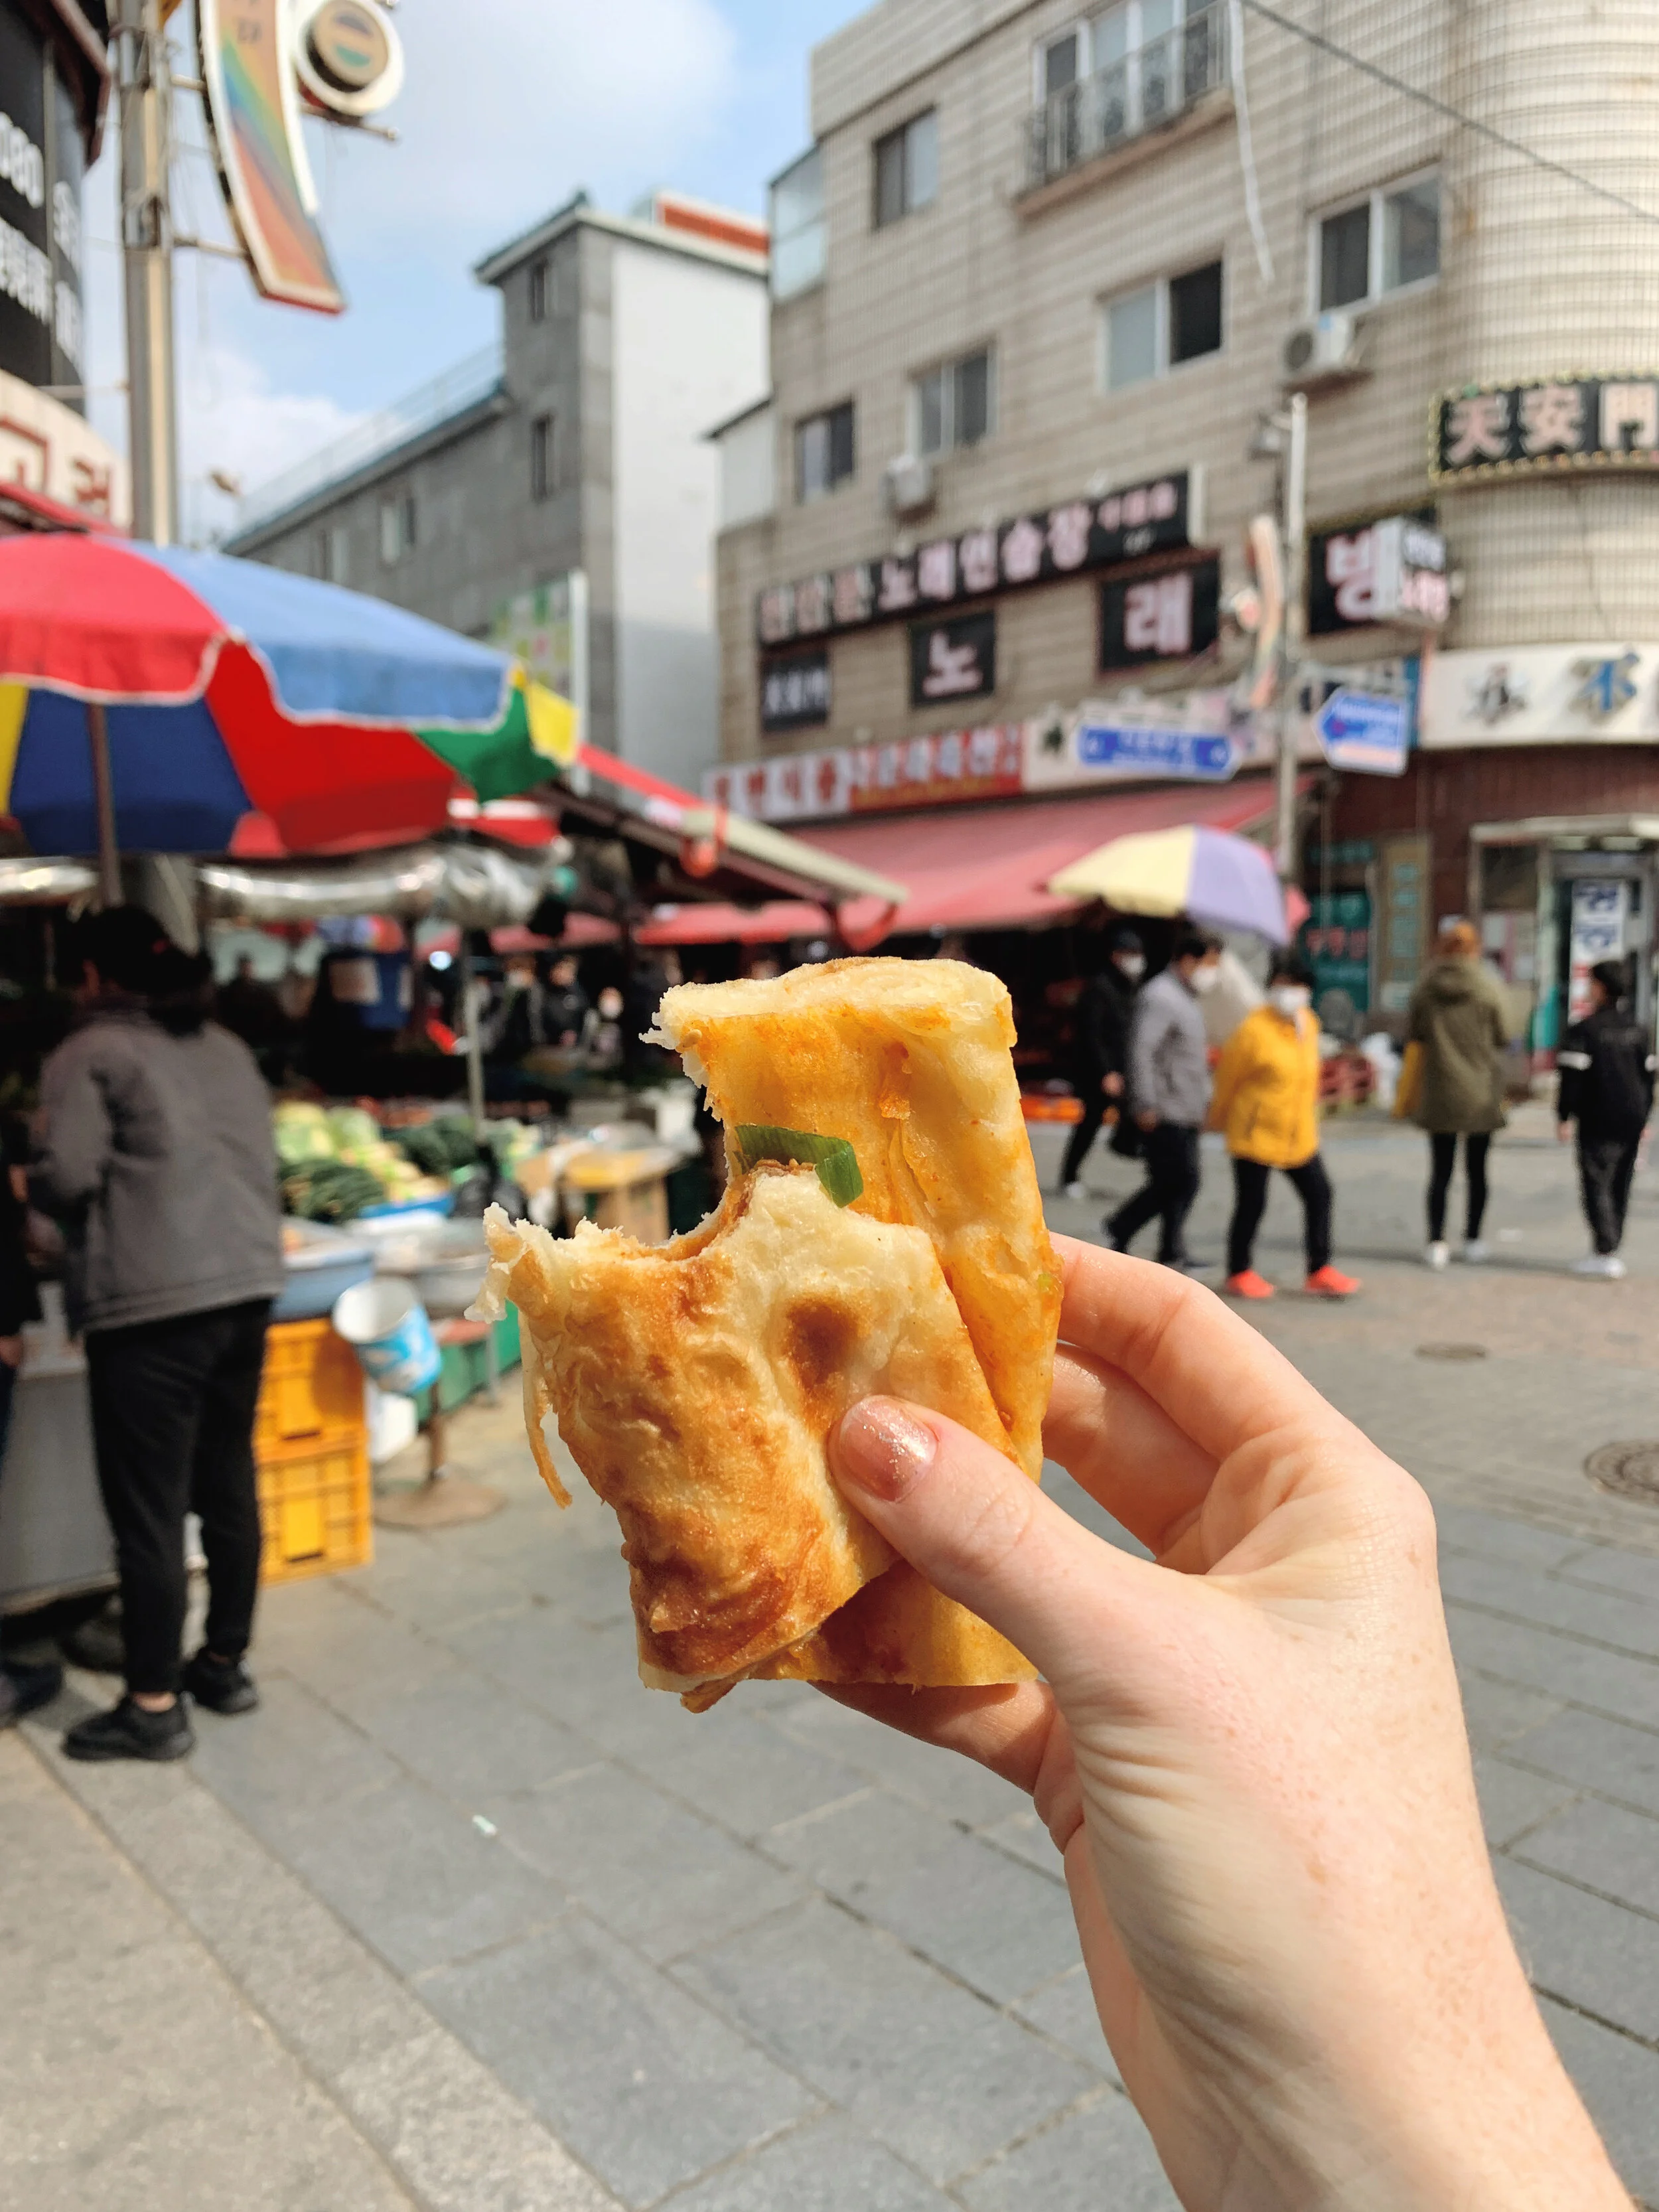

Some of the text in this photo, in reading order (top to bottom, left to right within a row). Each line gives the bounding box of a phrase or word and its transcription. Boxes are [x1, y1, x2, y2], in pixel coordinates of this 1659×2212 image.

[1445, 382, 1658, 466] 天安門
[878, 502, 1092, 611] 노래연습장
[1123, 571, 1193, 654] 래
[922, 628, 983, 697] 노
